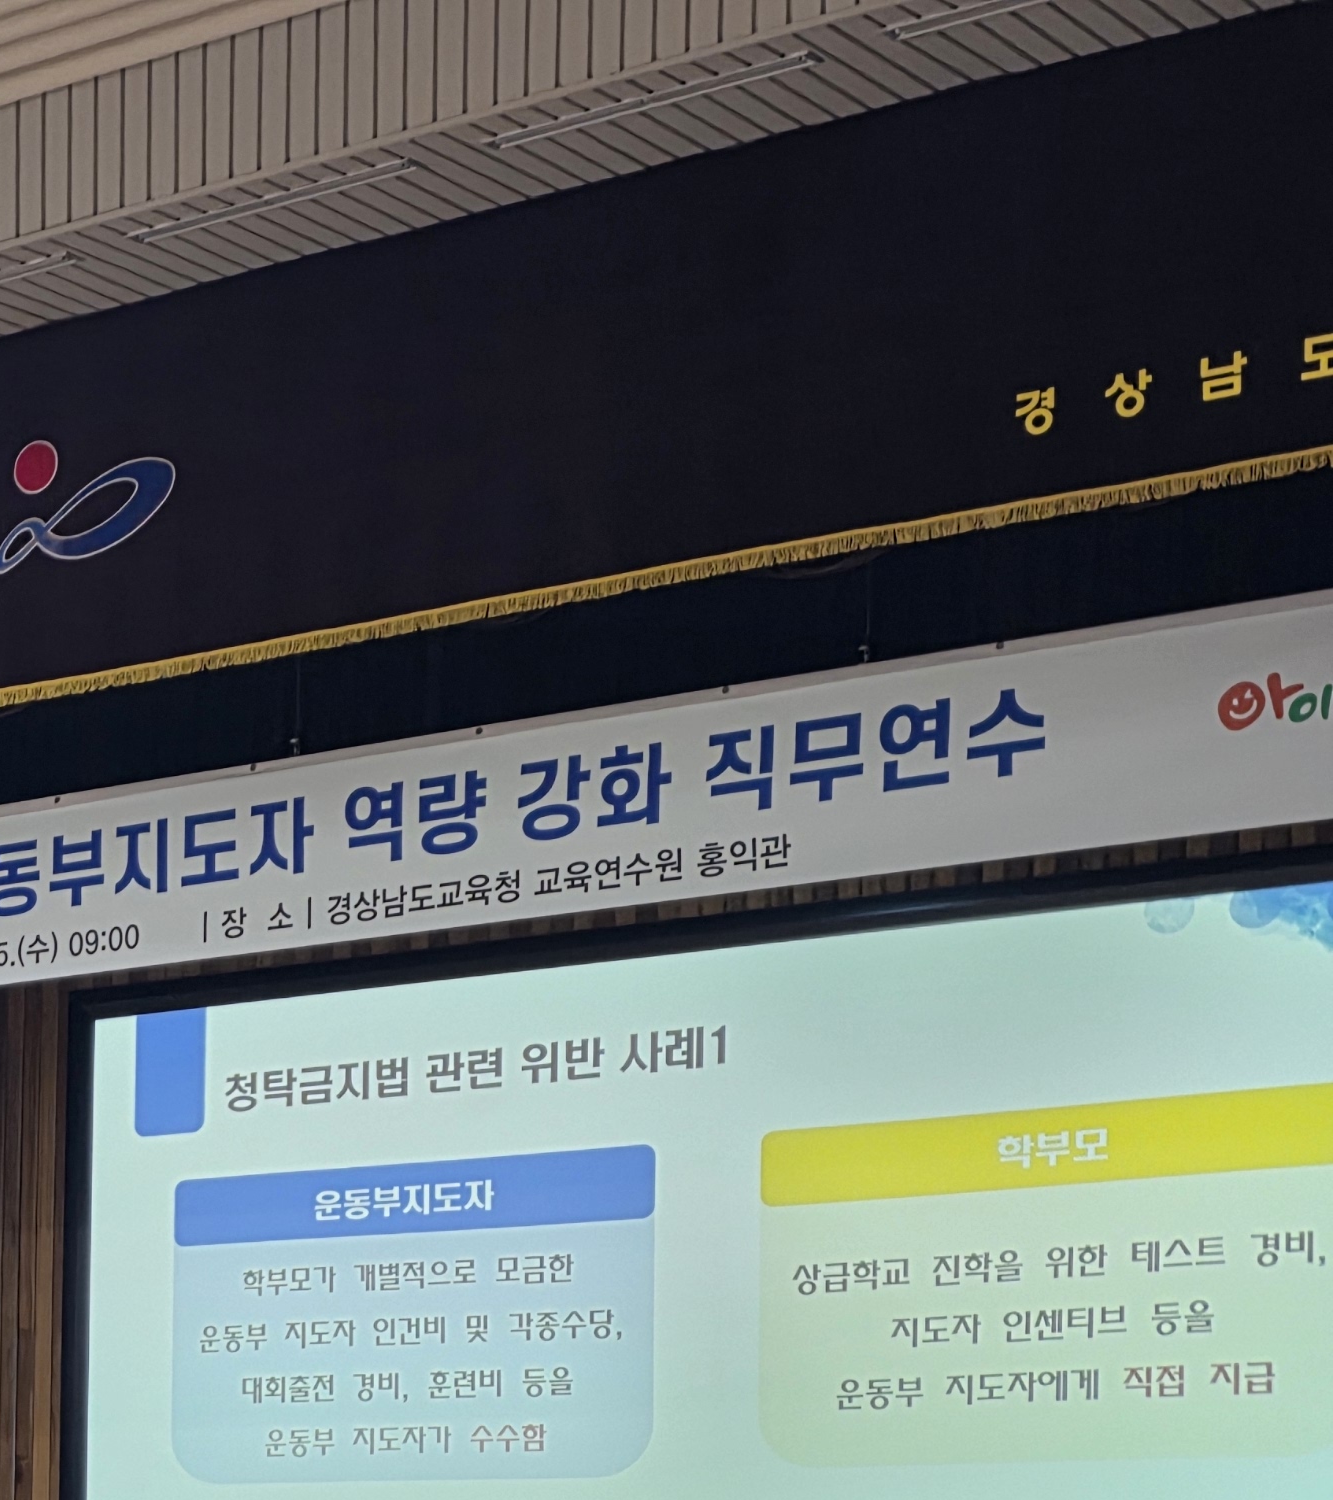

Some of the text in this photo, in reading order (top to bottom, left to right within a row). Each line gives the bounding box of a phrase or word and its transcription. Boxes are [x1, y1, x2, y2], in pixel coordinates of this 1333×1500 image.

[343, 769, 488, 863] 역량
[516, 739, 673, 841] 강화
[704, 687, 1047, 813] 직무연수
[327, 870, 521, 926] 경상남도교육청
[533, 846, 684, 898] 교육연수원
[696, 832, 792, 879] 홍익관
[67, 923, 141, 958] 09:00
[224, 1024, 728, 1113] 청탁금지법 관련 위반 사례1
[997, 1128, 1109, 1169] 학부모
[314, 1178, 495, 1221] 운동부지도자
[242, 1253, 574, 1295] 학부모가 개별적으로 모금한
[792, 1230, 1326, 1296] 상급학교 진학을 위한 테스트 경비,
[199, 1309, 624, 1354] 운동부 지도자 인건비 및 각종수당,
[891, 1300, 1215, 1348] 지도자 인센티브 등을
[242, 1367, 574, 1404] 대회출전 경비, 훈련비 등을
[836, 1361, 1276, 1411] 운동부 지도자에게 직접 지급
[265, 1423, 547, 1457] 운동부 지도자가 수수함
